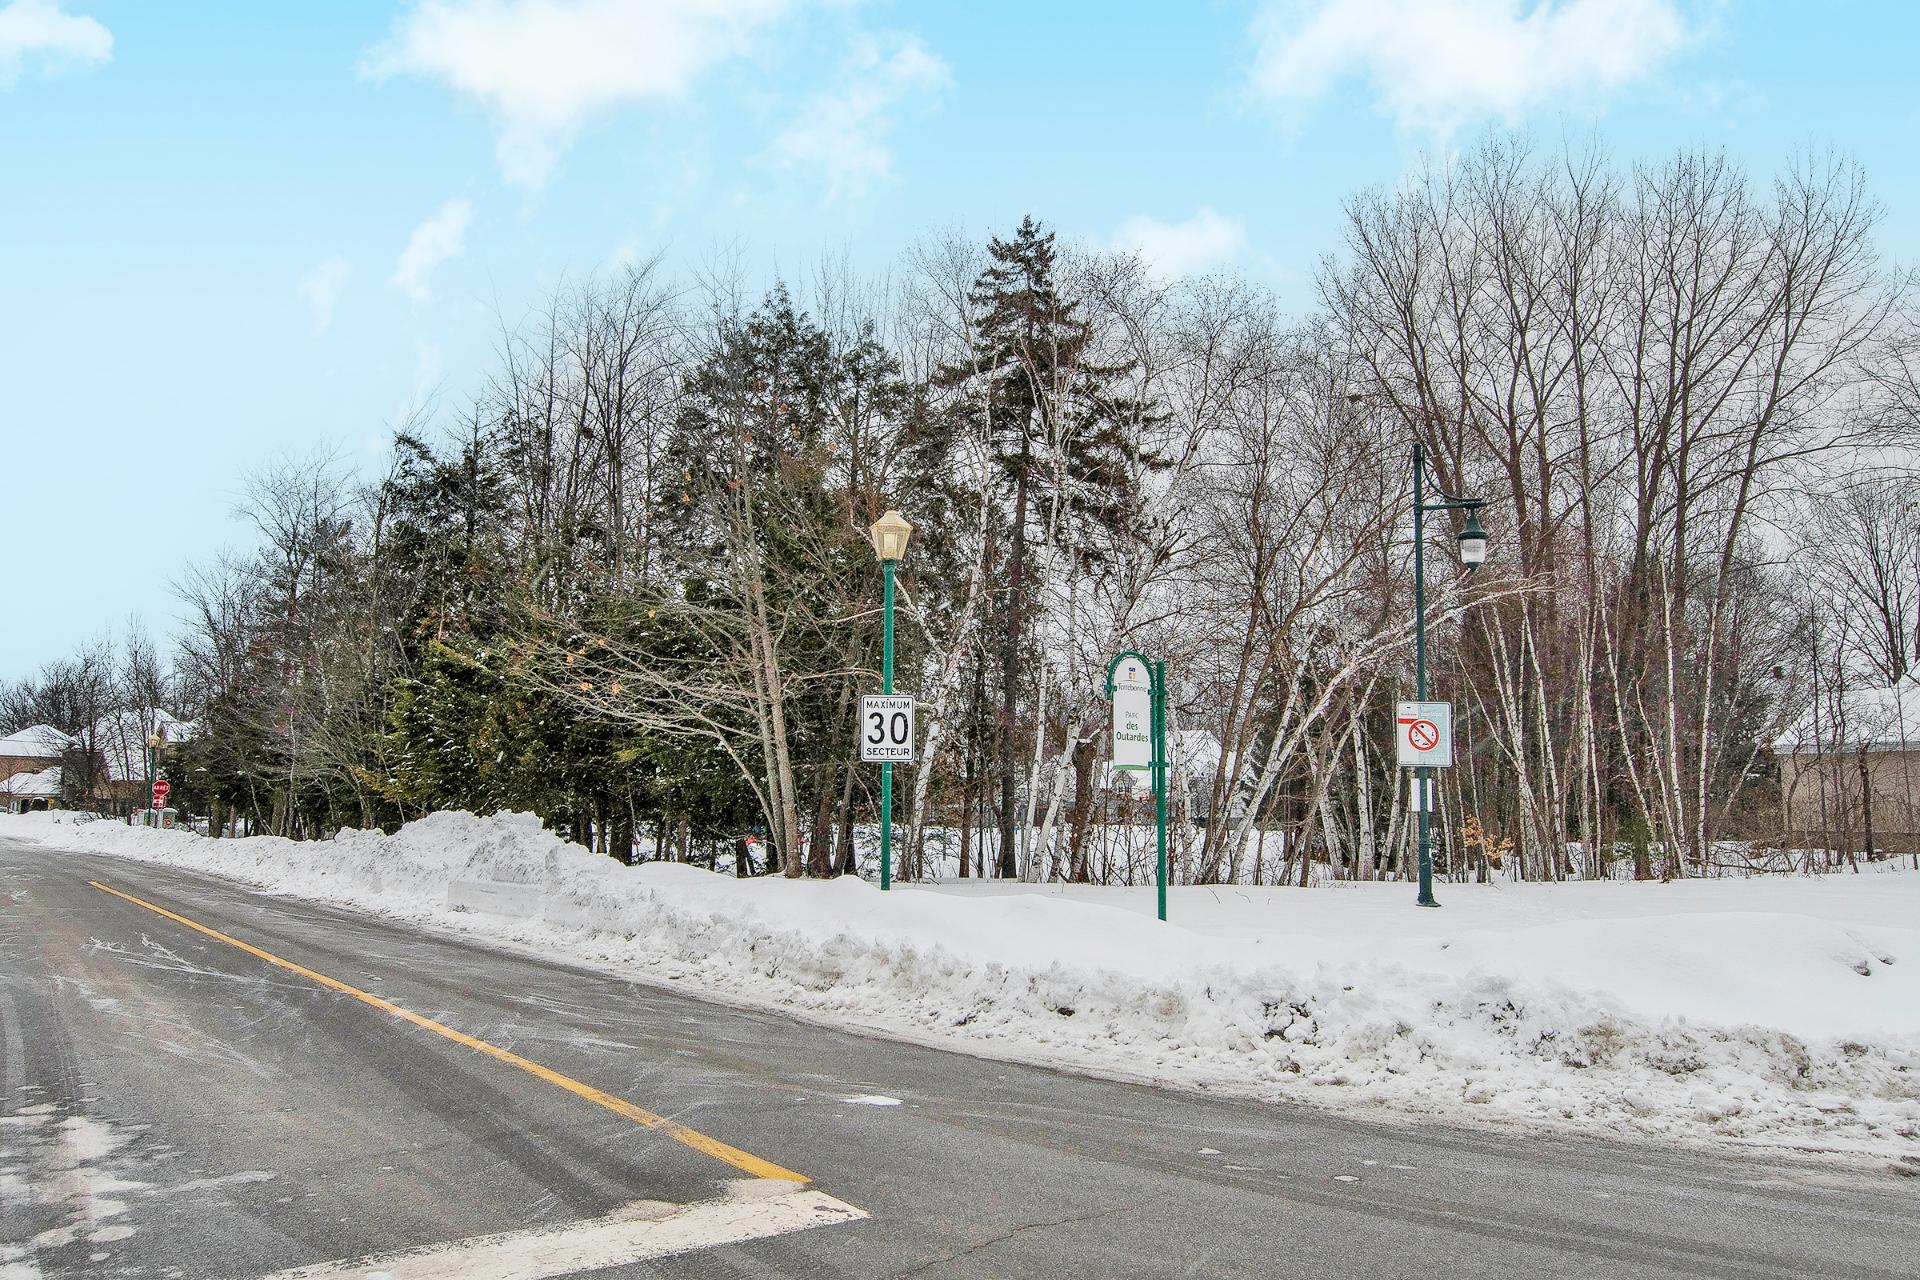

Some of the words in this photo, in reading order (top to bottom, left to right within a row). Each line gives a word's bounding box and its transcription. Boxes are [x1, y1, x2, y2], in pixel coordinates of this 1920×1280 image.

[866, 700, 910, 709] MAXIMUM
[867, 712, 909, 745] 30
[1126, 721, 1139, 730] des
[1116, 731, 1149, 742] Outardes
[866, 747, 910, 756] SECTEUR
